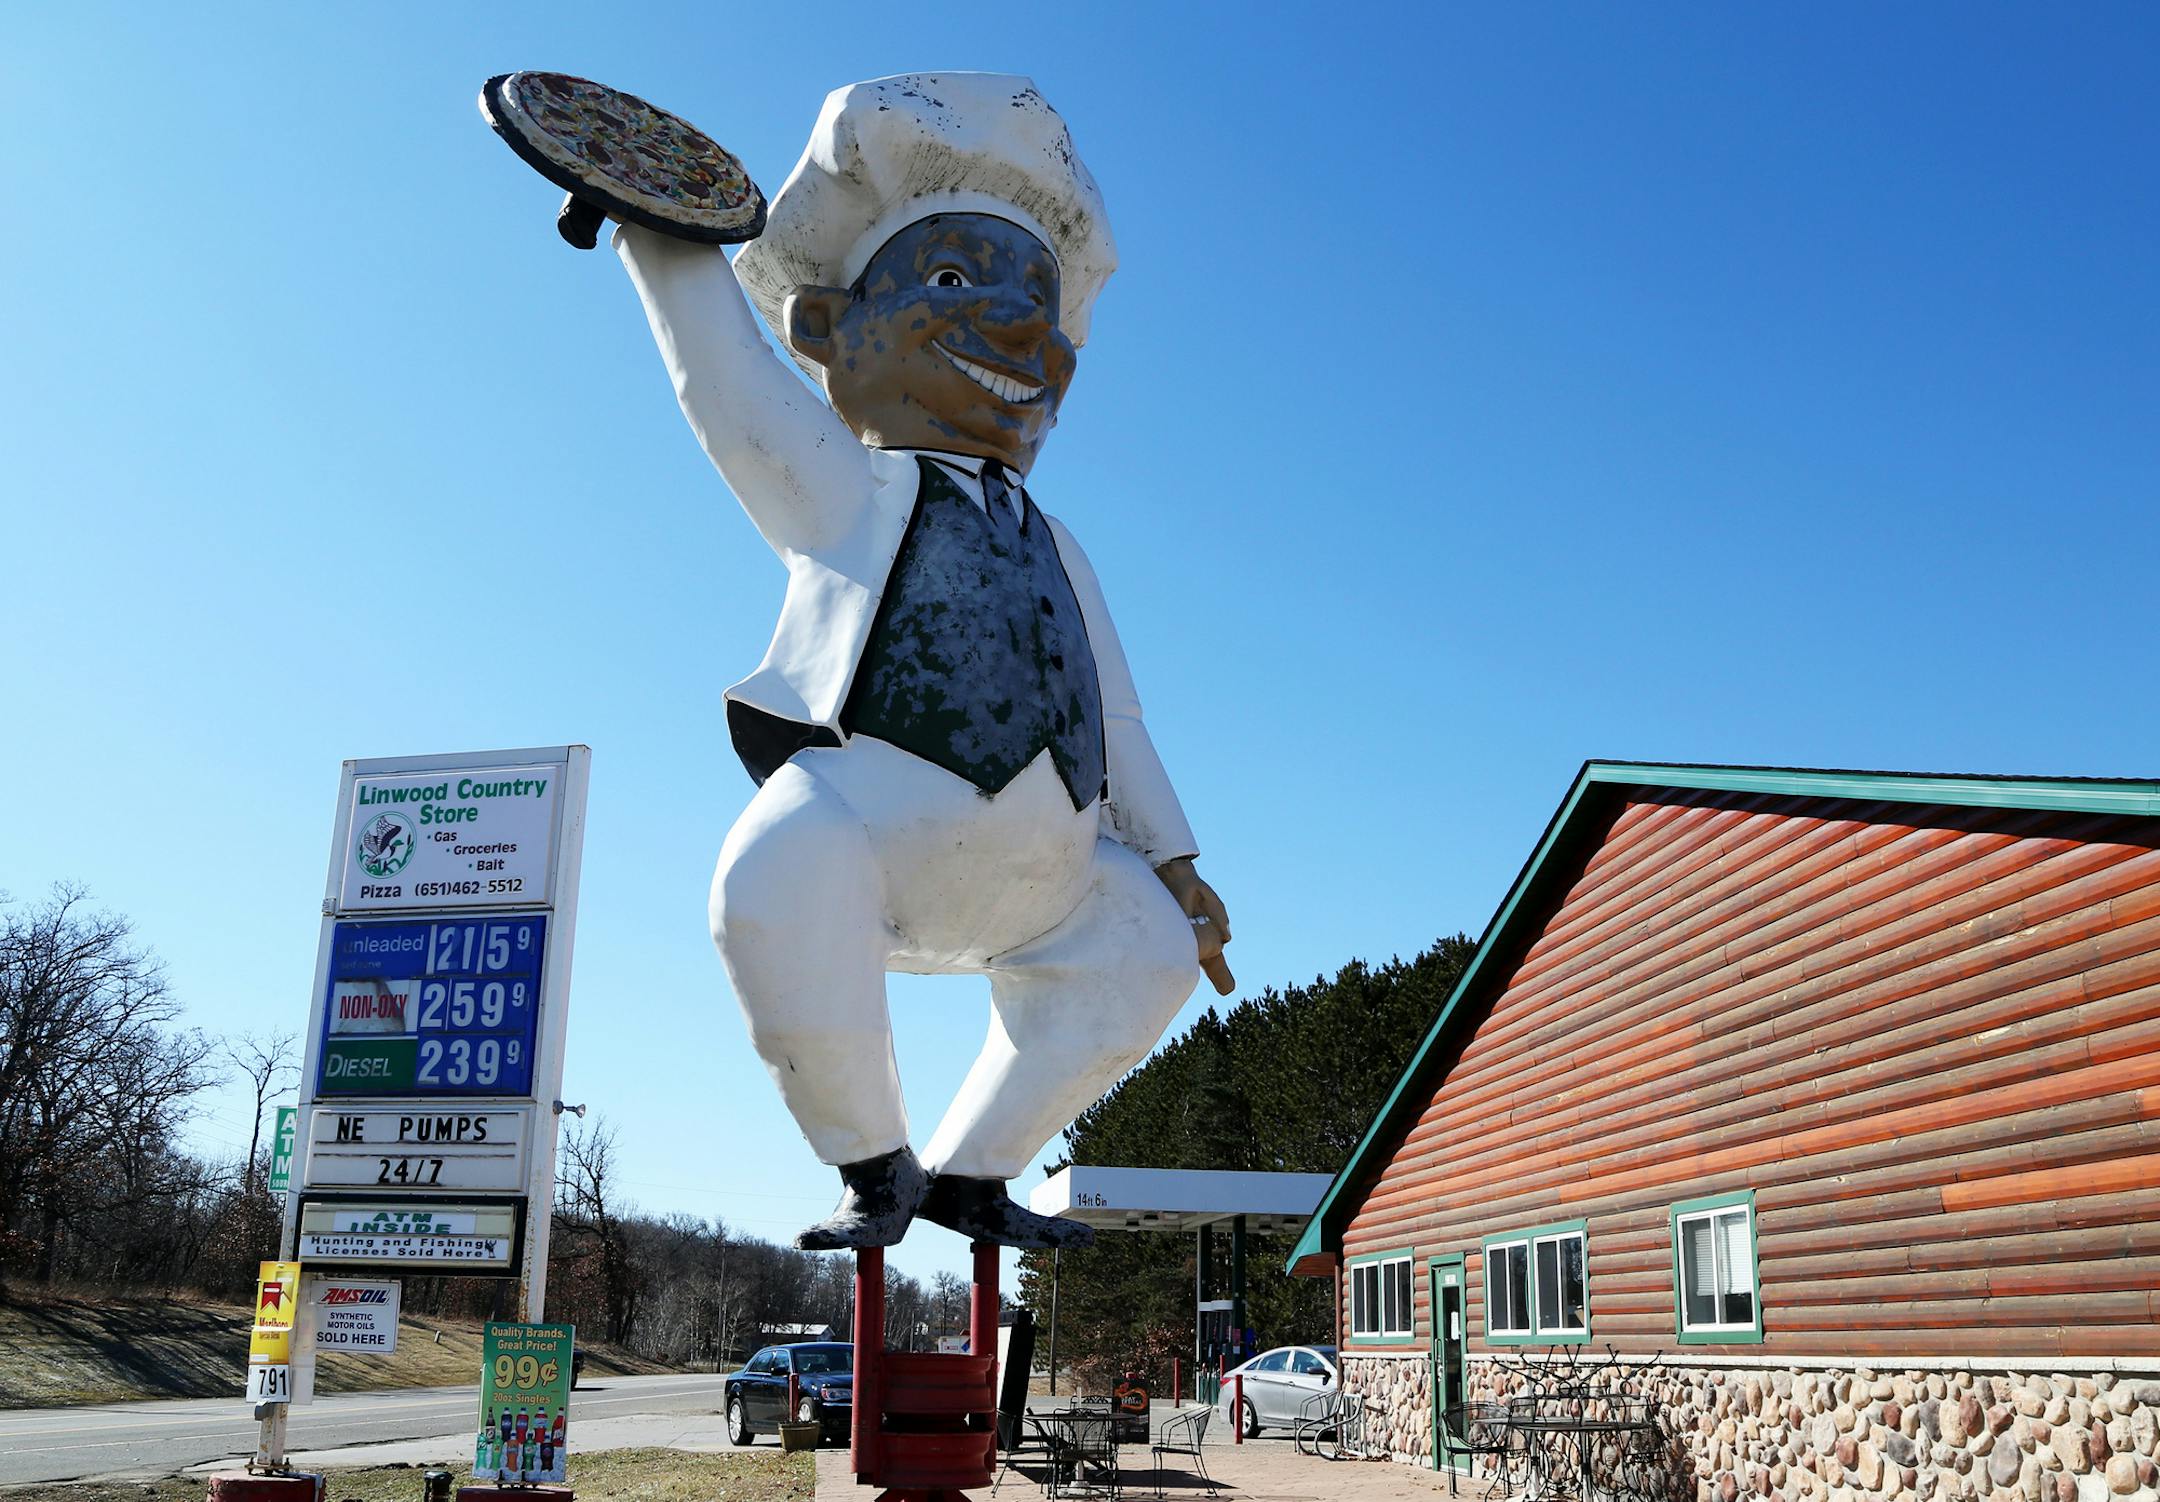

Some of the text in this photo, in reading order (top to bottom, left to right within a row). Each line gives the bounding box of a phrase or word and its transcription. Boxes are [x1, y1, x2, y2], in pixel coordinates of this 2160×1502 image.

[358, 778, 547, 805] Linwood Country
[419, 804, 478, 825] Store
[434, 831, 457, 842] Gas
[453, 843, 517, 856] Groceries
[477, 859, 505, 871] Bait
[360, 885, 402, 898] Pizza
[339, 994, 408, 1019] NON-OXY
[336, 1117, 488, 1141] NE PUMPS
[378, 1159, 443, 1183] 24/7
[373, 1213, 432, 1222] ATM
[350, 1222, 452, 1234] INSIDE
[311, 1236, 484, 1249] Hunting and Fishing
[316, 1246, 483, 1258] Licenses Sold Here
[320, 1288, 389, 1305] AMSOIL
[330, 1312, 373, 1321] SYNTHETIC
[327, 1321, 375, 1330] MOTOR OILS
[316, 1331, 386, 1345] SOLD HERE
[491, 1326, 566, 1339] Quality Brands.
[498, 1339, 557, 1351] Great Price!
[494, 1354, 559, 1390] 99¢
[494, 1392, 551, 1405] 20oz Singles
